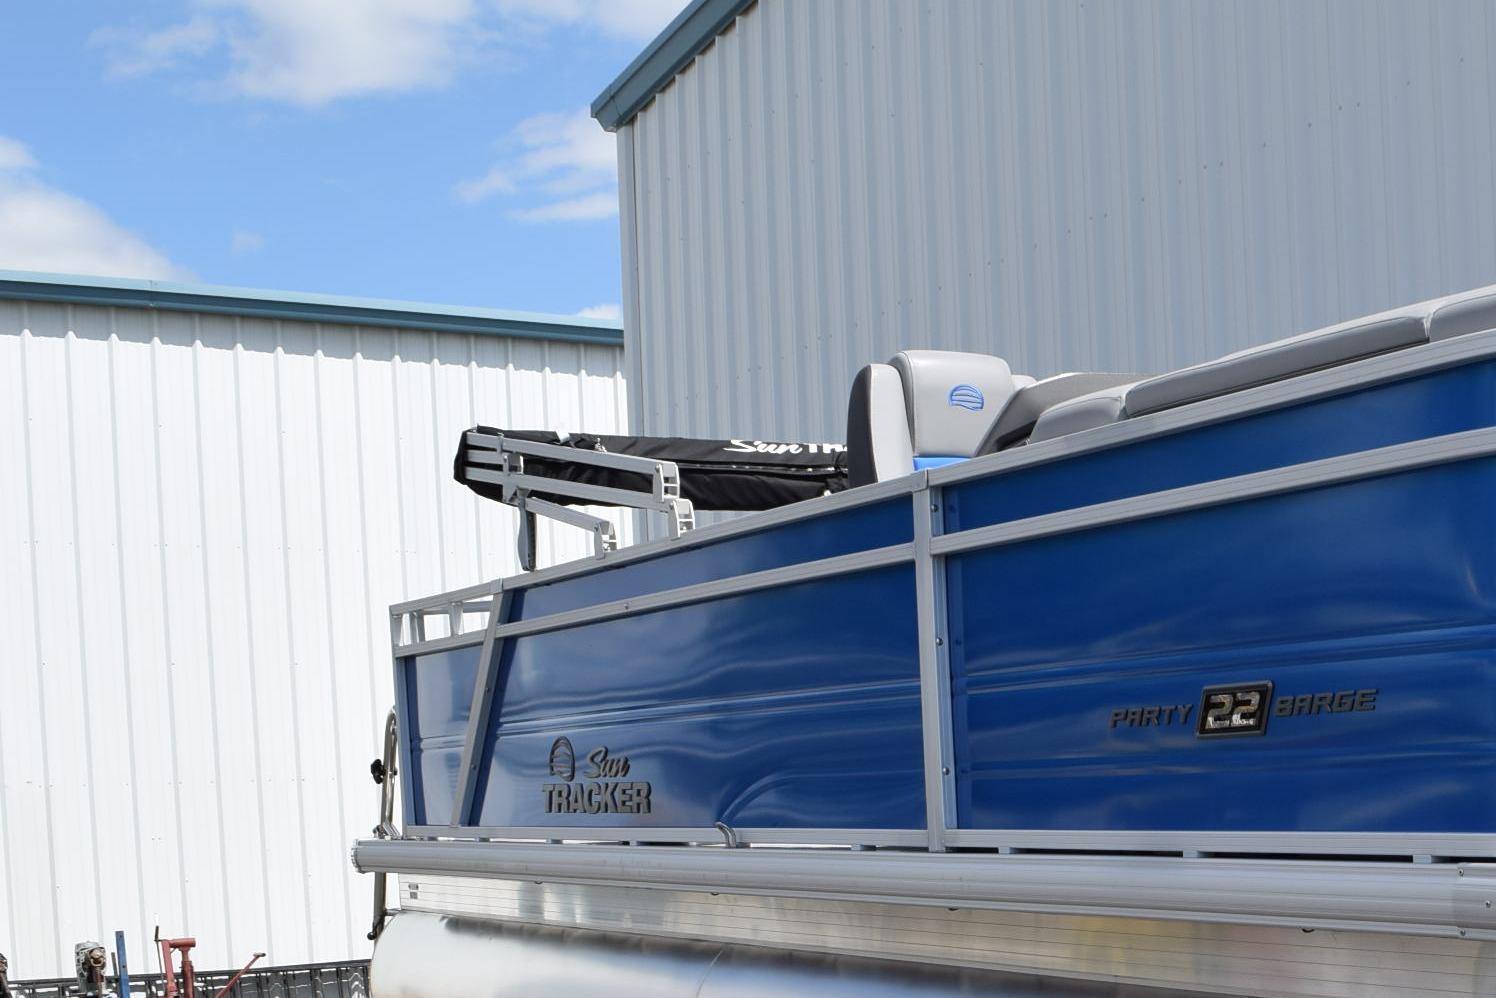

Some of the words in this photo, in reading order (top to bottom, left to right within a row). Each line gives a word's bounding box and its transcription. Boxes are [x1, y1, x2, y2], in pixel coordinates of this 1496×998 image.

[1109, 703, 1195, 729] PARTY
[1204, 691, 1261, 730] 22
[1275, 688, 1380, 717] BARGE
[583, 745, 631, 779] Sun
[542, 781, 652, 814] TRACKER
